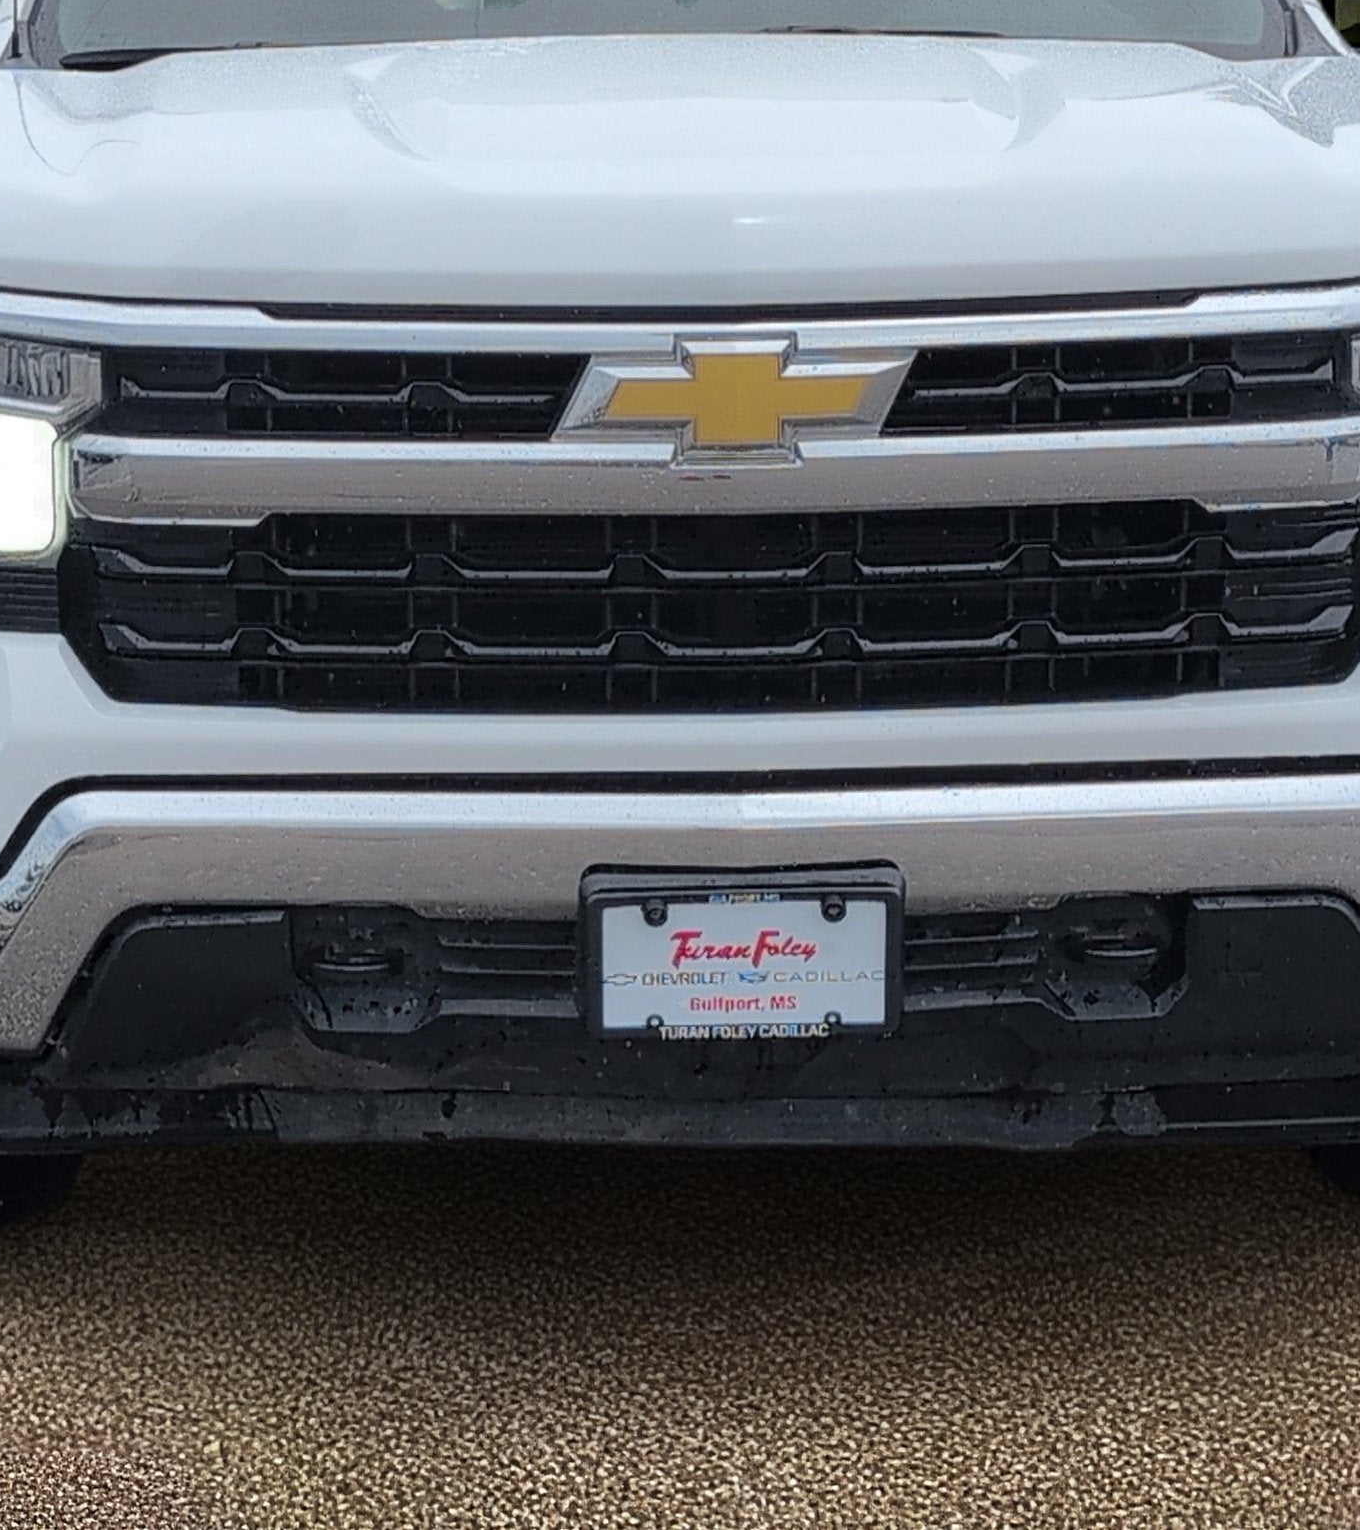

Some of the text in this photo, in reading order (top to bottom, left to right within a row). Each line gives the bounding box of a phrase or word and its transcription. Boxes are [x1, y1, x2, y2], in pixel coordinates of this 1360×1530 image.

[670, 930, 817, 969] Turan Foley
[642, 970, 884, 986] CHEVROLET CADILLAC
[690, 995, 797, 1013] Gulfport, MS
[659, 1023, 830, 1040] TURAN FOLEY CADILLAC
